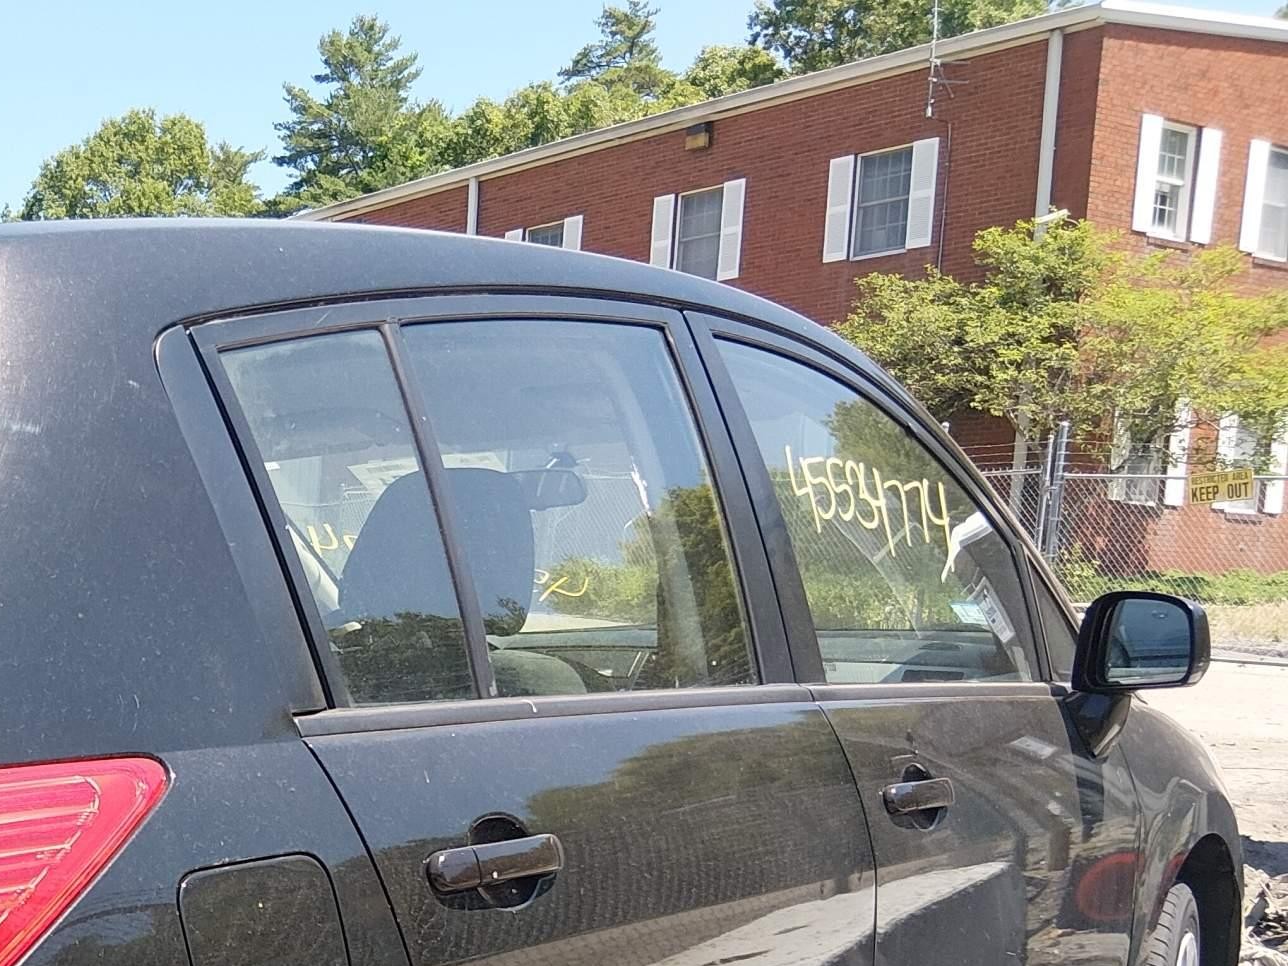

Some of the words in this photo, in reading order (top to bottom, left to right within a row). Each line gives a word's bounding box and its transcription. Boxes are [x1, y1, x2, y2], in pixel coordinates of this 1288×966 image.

[1191, 474, 1229, 485] RESTRICTED
[1232, 472, 1248, 480] AREA
[1191, 485, 1219, 502] KEEP
[1227, 482, 1249, 499] OUT
[785, 445, 955, 572] 45534774
